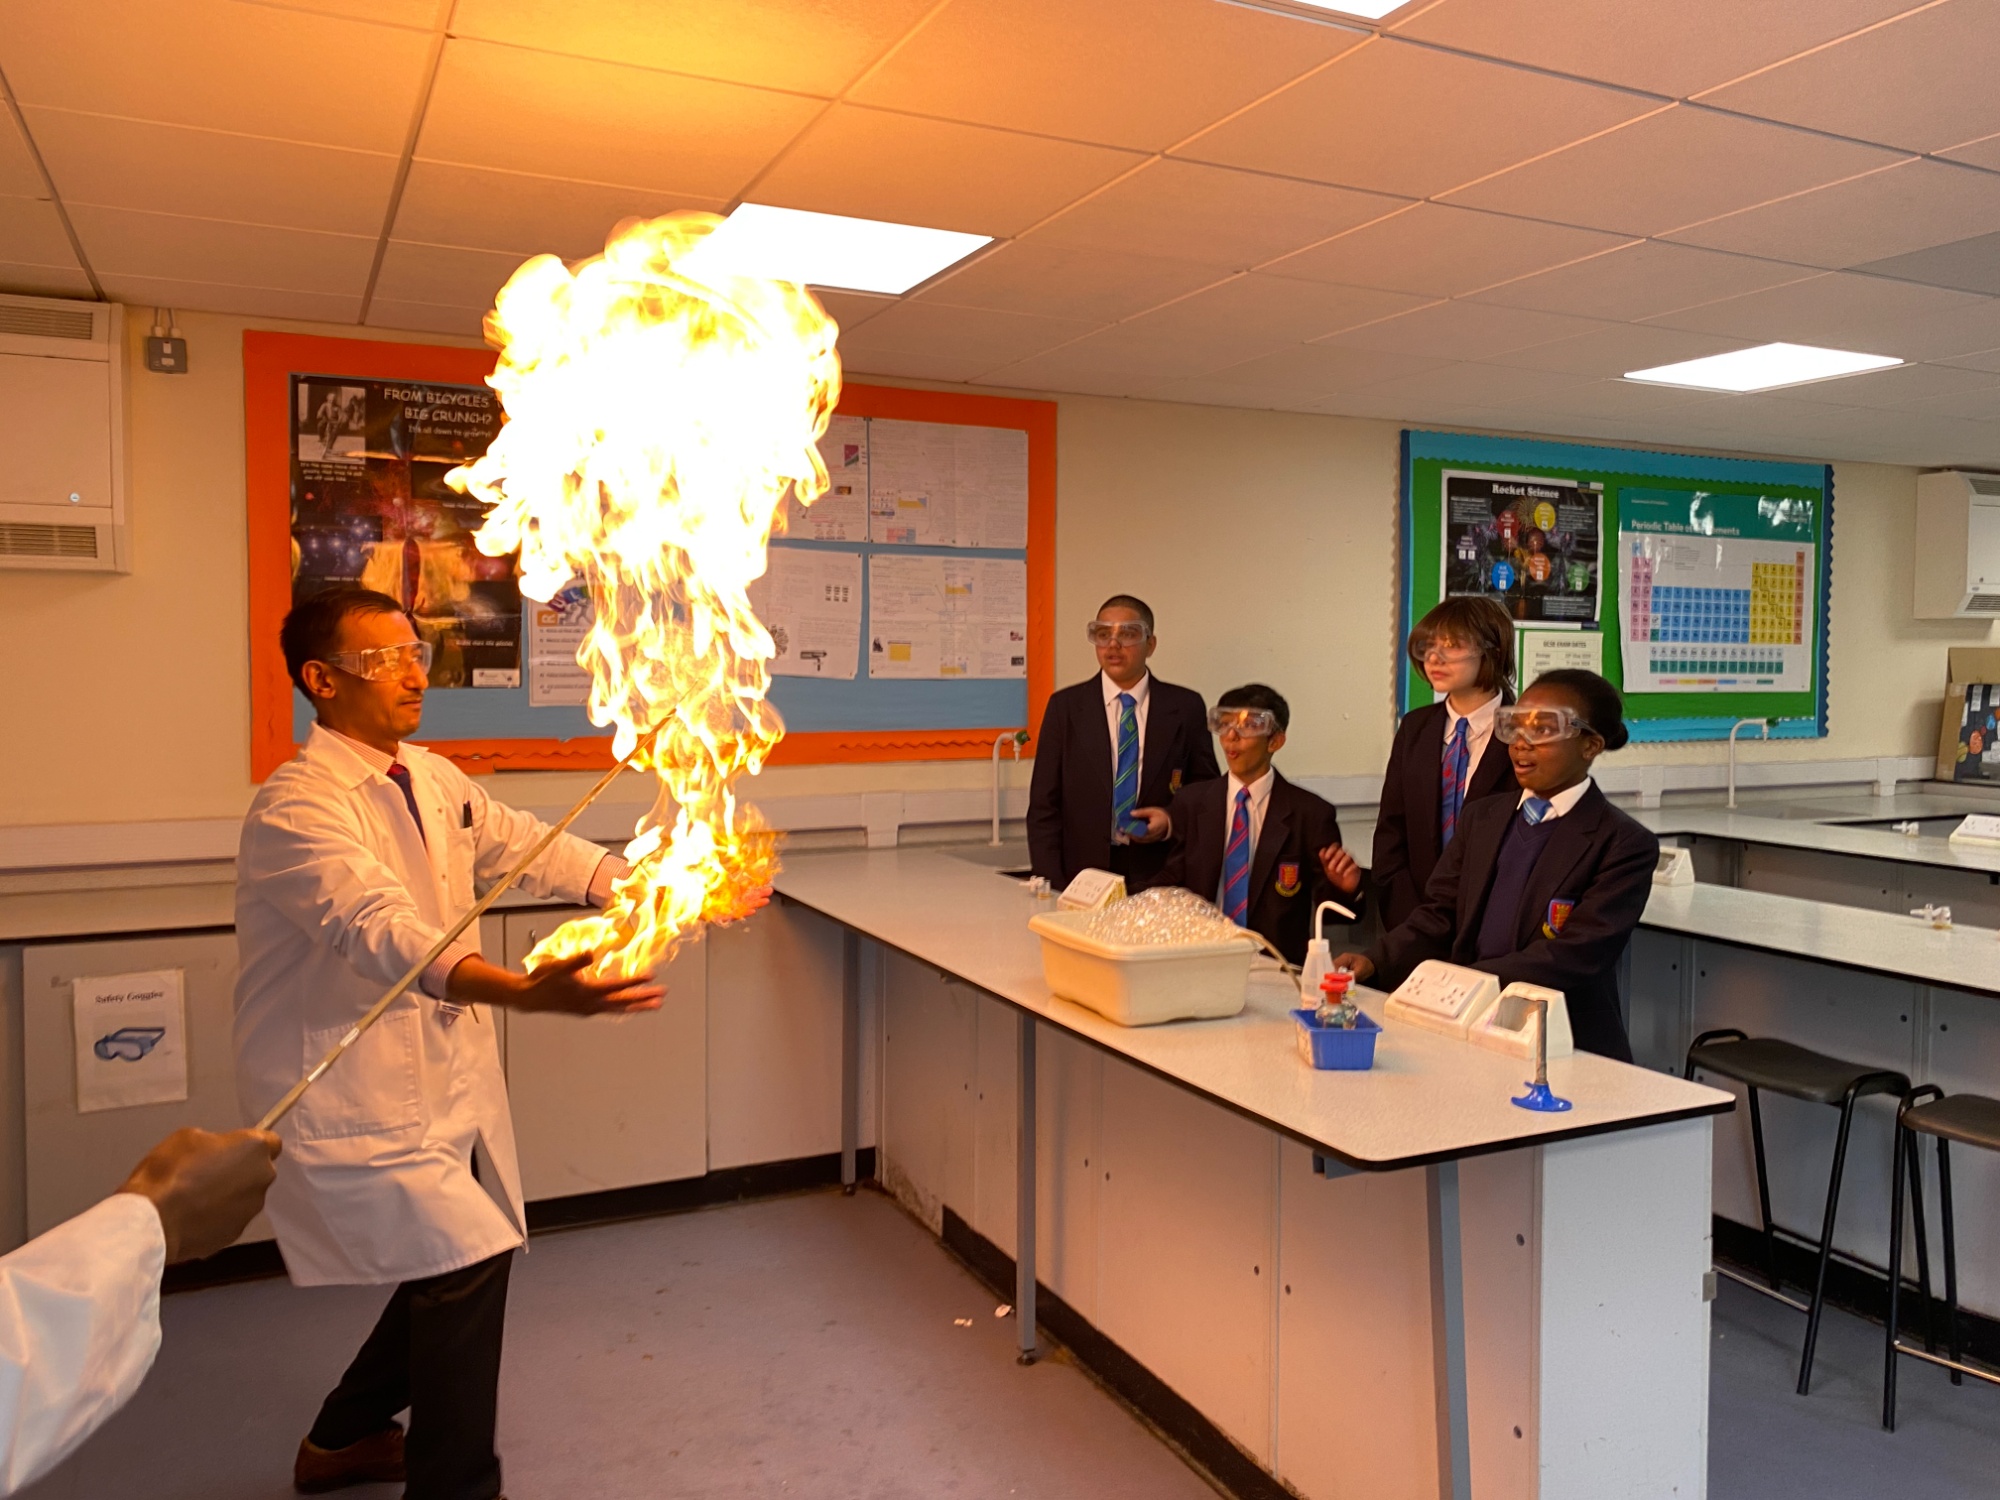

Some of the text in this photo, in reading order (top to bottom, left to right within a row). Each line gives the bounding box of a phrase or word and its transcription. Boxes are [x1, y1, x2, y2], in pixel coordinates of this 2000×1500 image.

[384, 388, 490, 408] FROM BICYCLES
[404, 407, 493, 425] BIG CRUNCH?
[422, 426, 432, 434] all
[433, 426, 452, 435] down
[453, 428, 462, 436] to
[1492, 483, 1560, 499] Rocket Science
[1631, 519, 1662, 532] Periodic
[1663, 520, 1684, 533] Table
[1707, 525, 1740, 536] ements
[95, 990, 164, 1004] Safety Goggles
